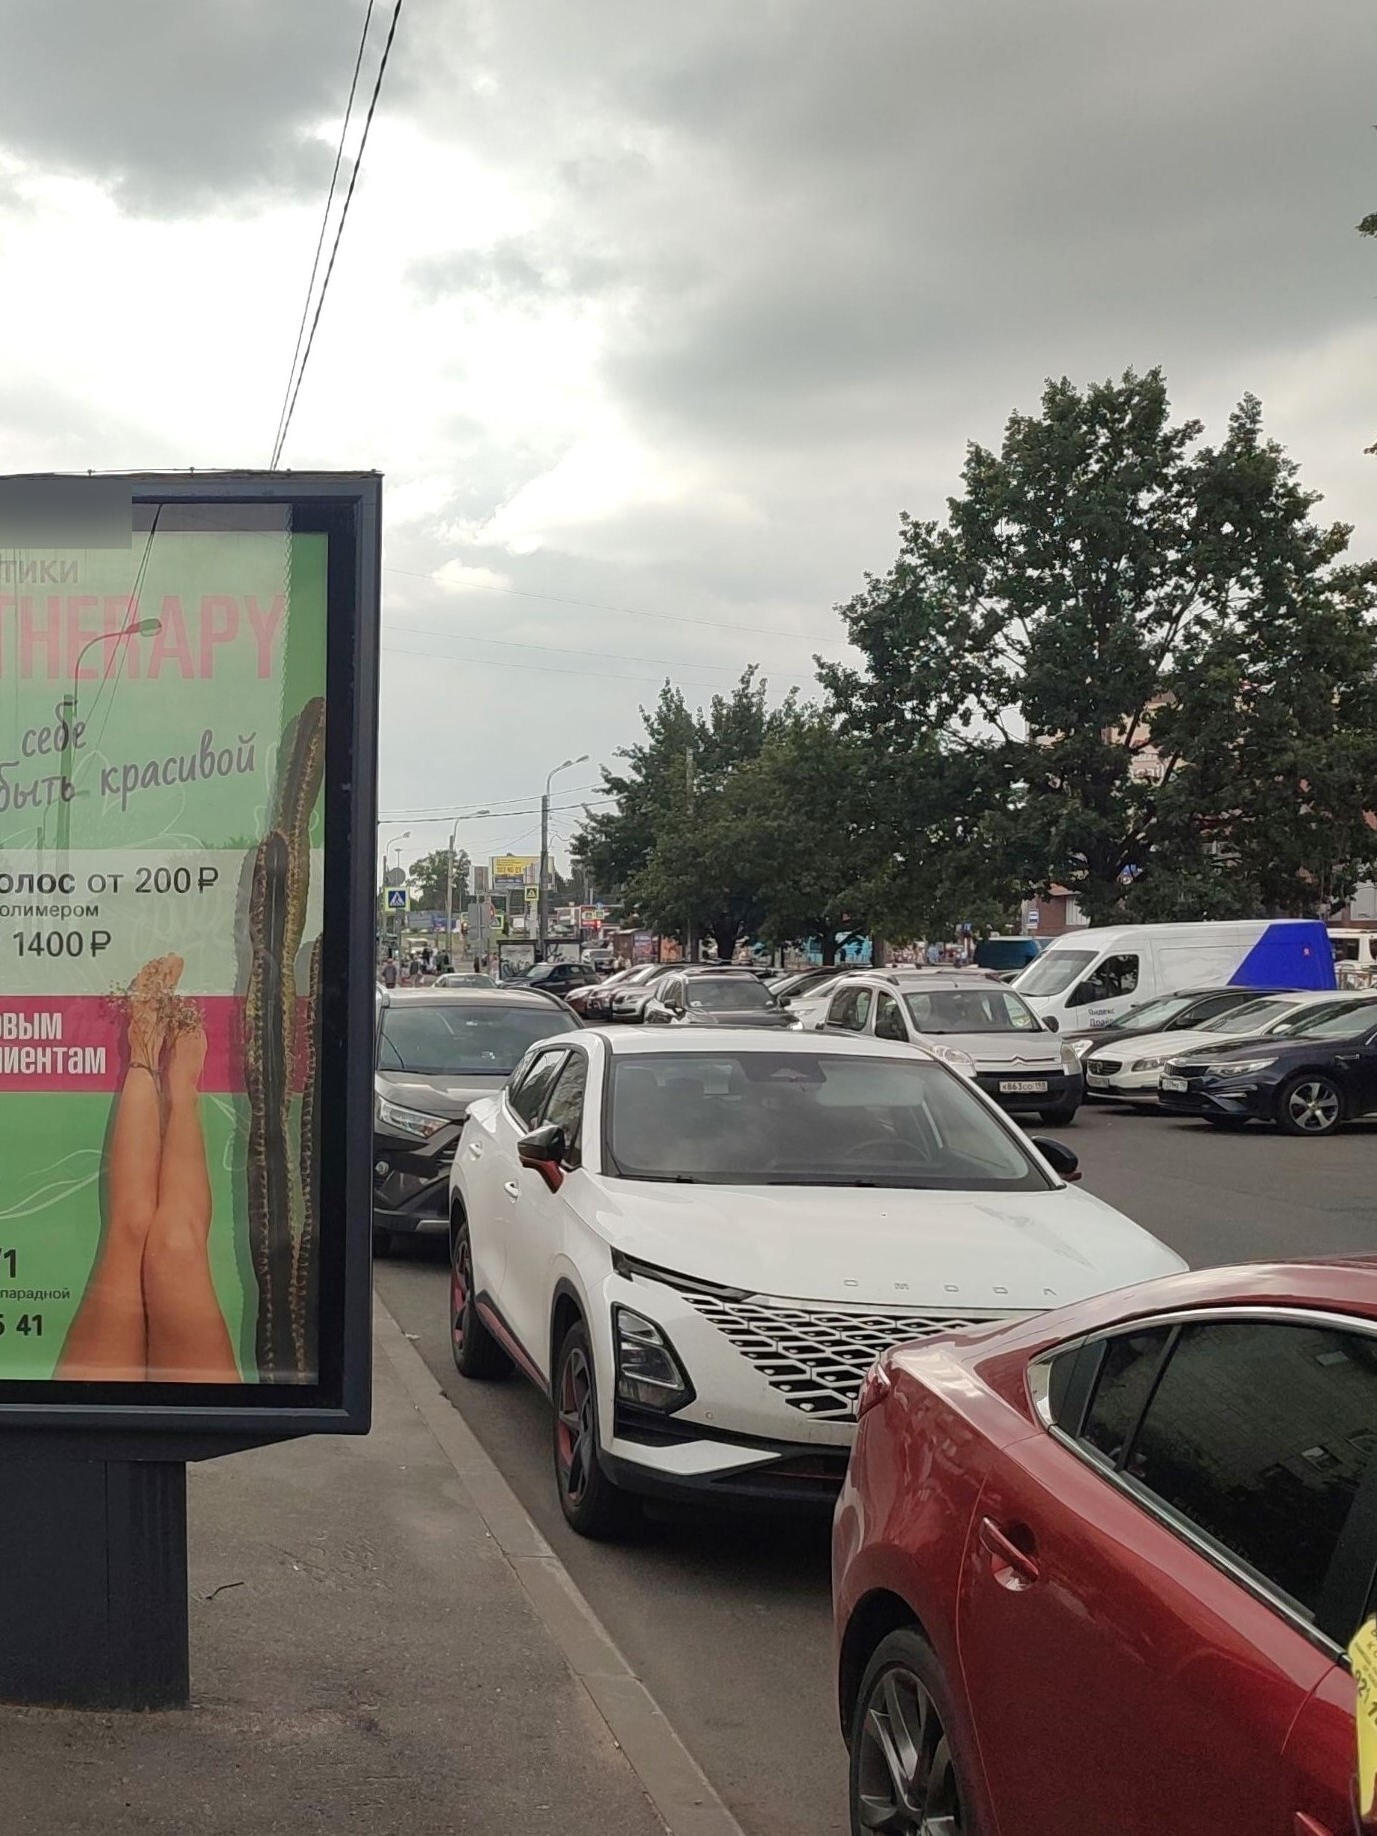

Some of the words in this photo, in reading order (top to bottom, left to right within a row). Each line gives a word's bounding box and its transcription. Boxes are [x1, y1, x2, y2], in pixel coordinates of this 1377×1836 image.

[22, 701, 87, 757] себе
[99, 729, 257, 812] красивой
[87, 873, 124, 894] от
[0, 1287, 70, 1301] парадной
[16, 1314, 43, 1337] 41
